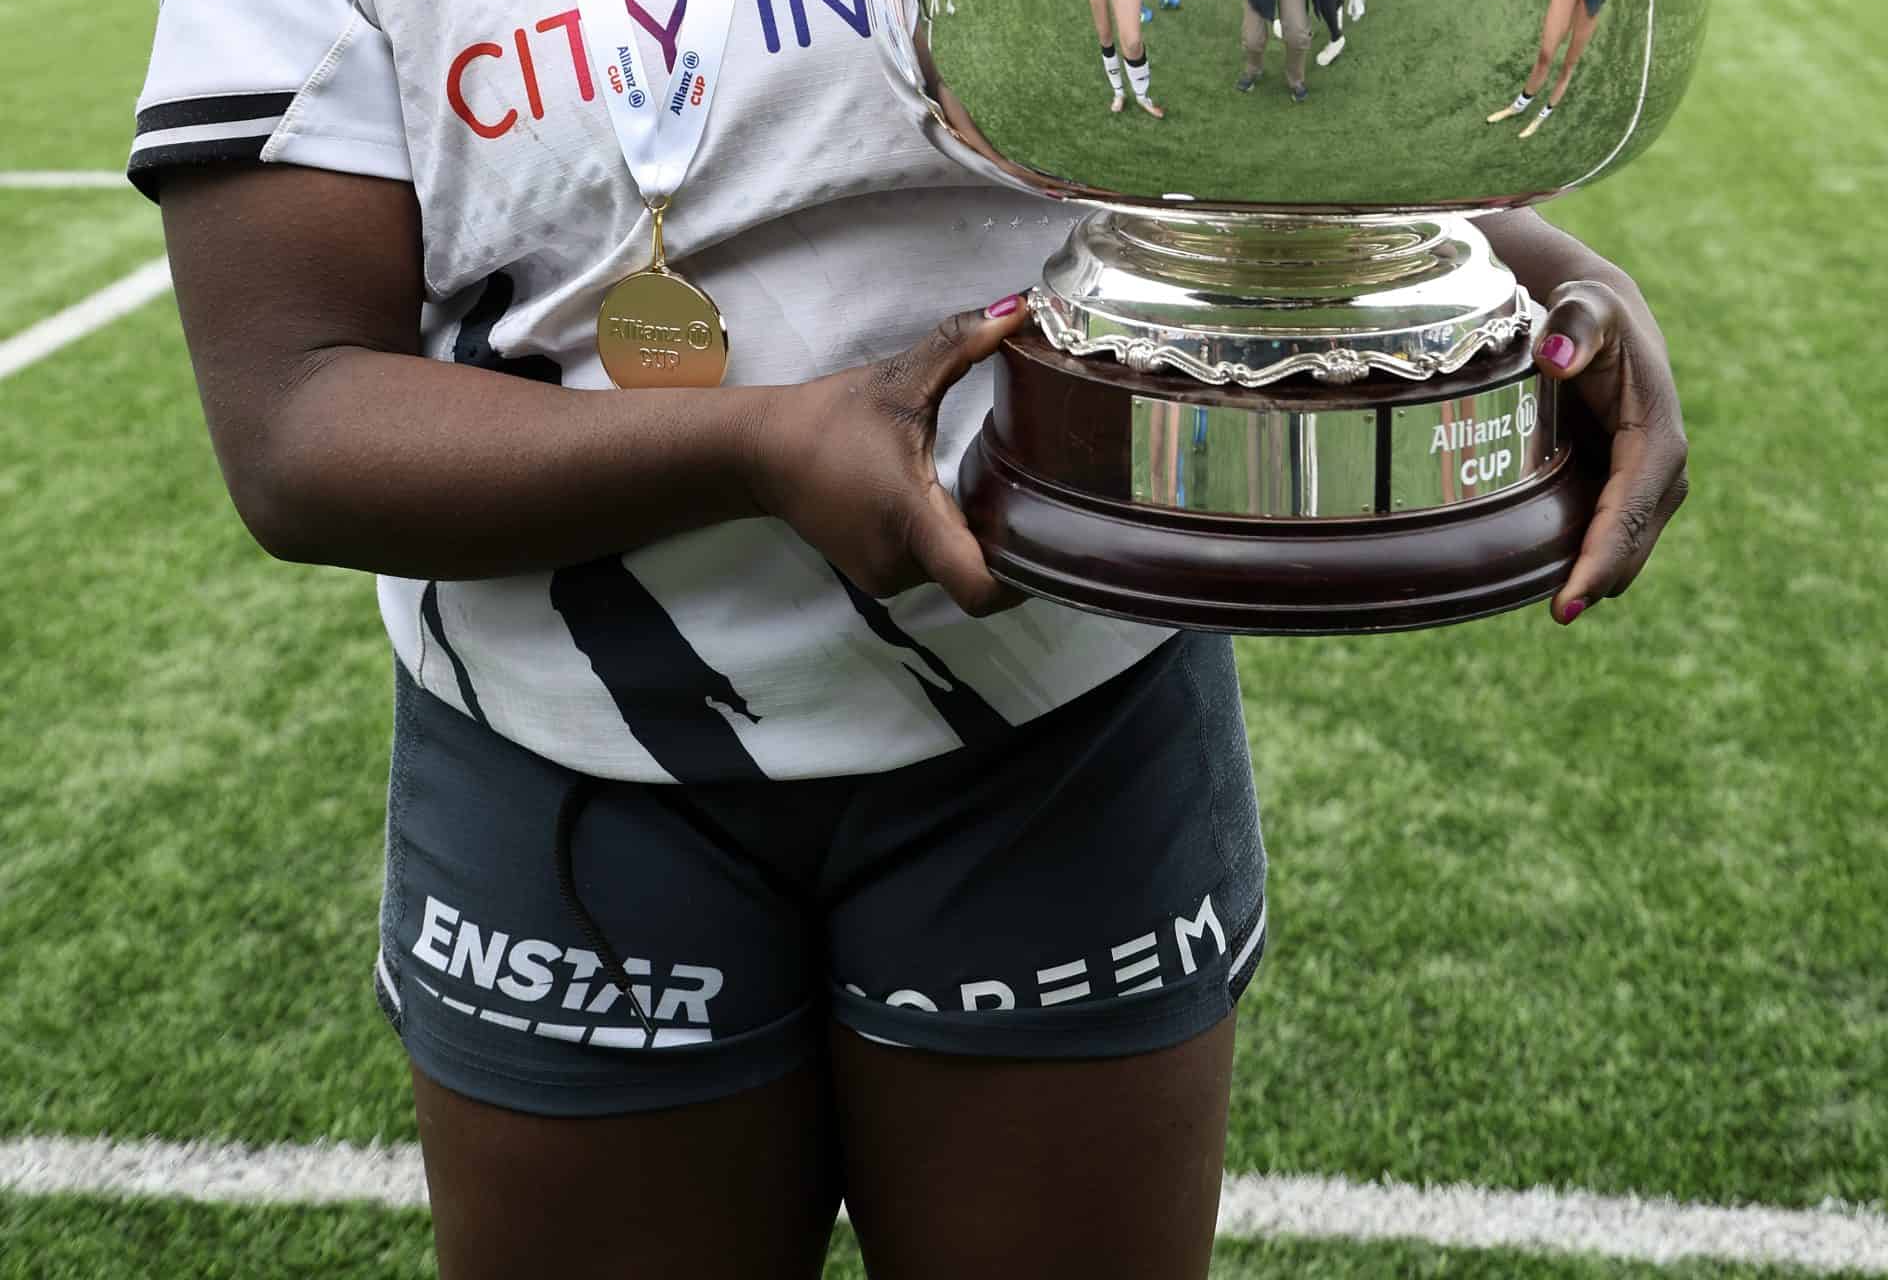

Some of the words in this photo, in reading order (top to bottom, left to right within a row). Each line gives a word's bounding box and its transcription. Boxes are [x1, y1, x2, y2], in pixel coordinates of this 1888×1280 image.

[607, 65, 624, 95] CUP
[616, 45, 637, 90] Allianz
[669, 70, 694, 116] Allianz
[690, 75, 706, 107] CUP
[609, 316, 682, 344] Allianz
[639, 346, 681, 369] CUP
[1430, 413, 1512, 455] Allianz
[1460, 448, 1512, 486] CUP
[411, 895, 724, 1023] ENSTAR
